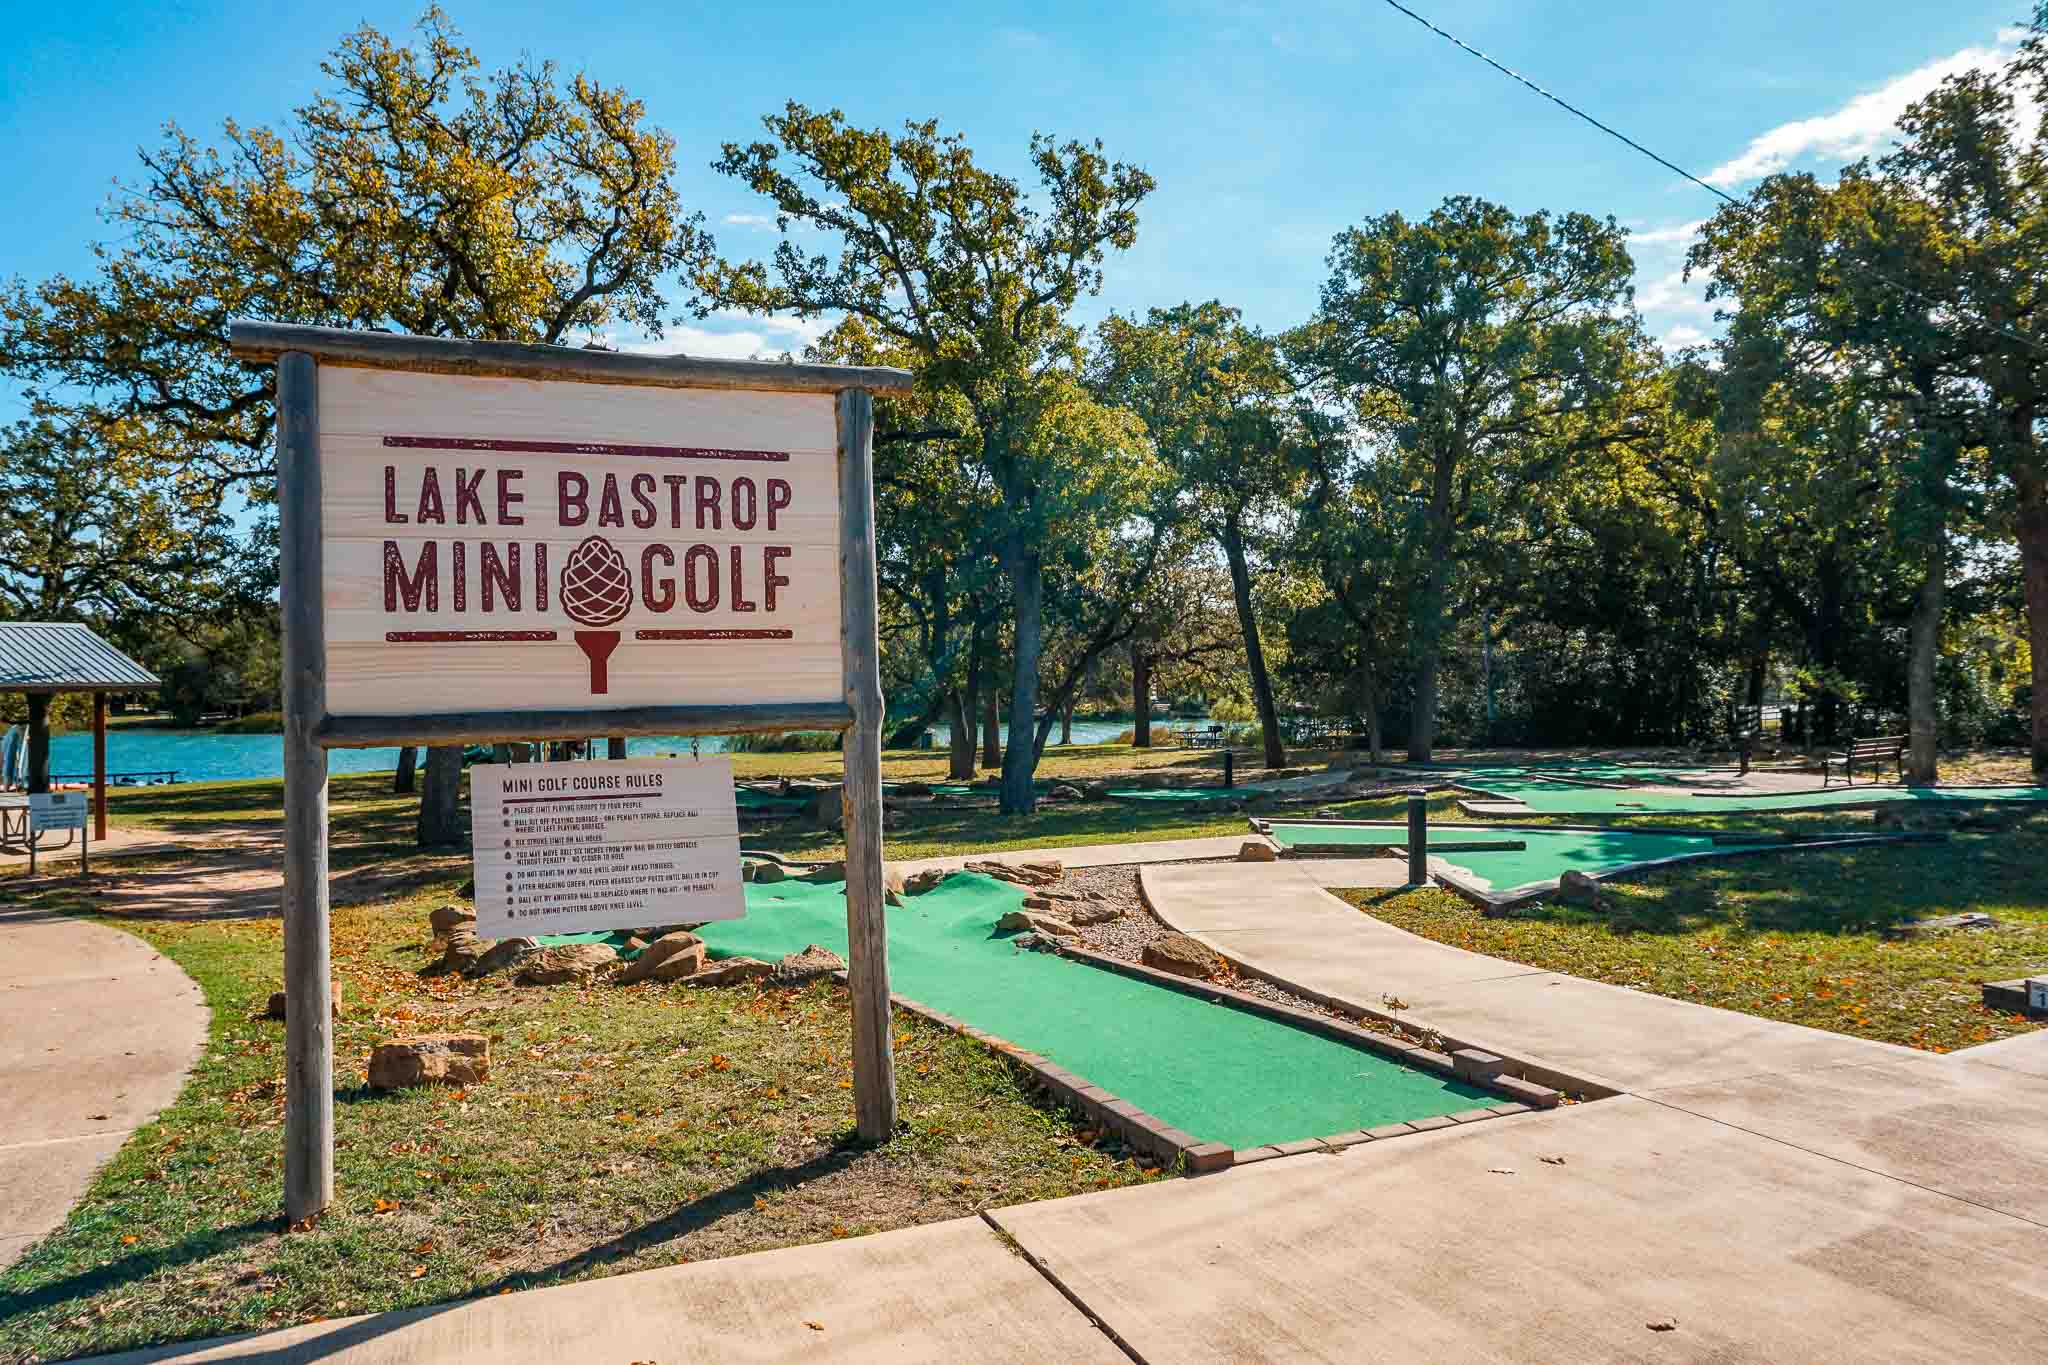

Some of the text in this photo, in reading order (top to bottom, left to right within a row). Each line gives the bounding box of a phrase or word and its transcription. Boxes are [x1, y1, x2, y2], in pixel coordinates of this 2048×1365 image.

[384, 465, 792, 531] LAKE BASTROP
[383, 541, 792, 613] MINI GOLF
[503, 774, 663, 792] MINI GOLF COURSE RULES
[601, 889, 629, 897] REPLACED
[631, 888, 649, 896] WHERE
